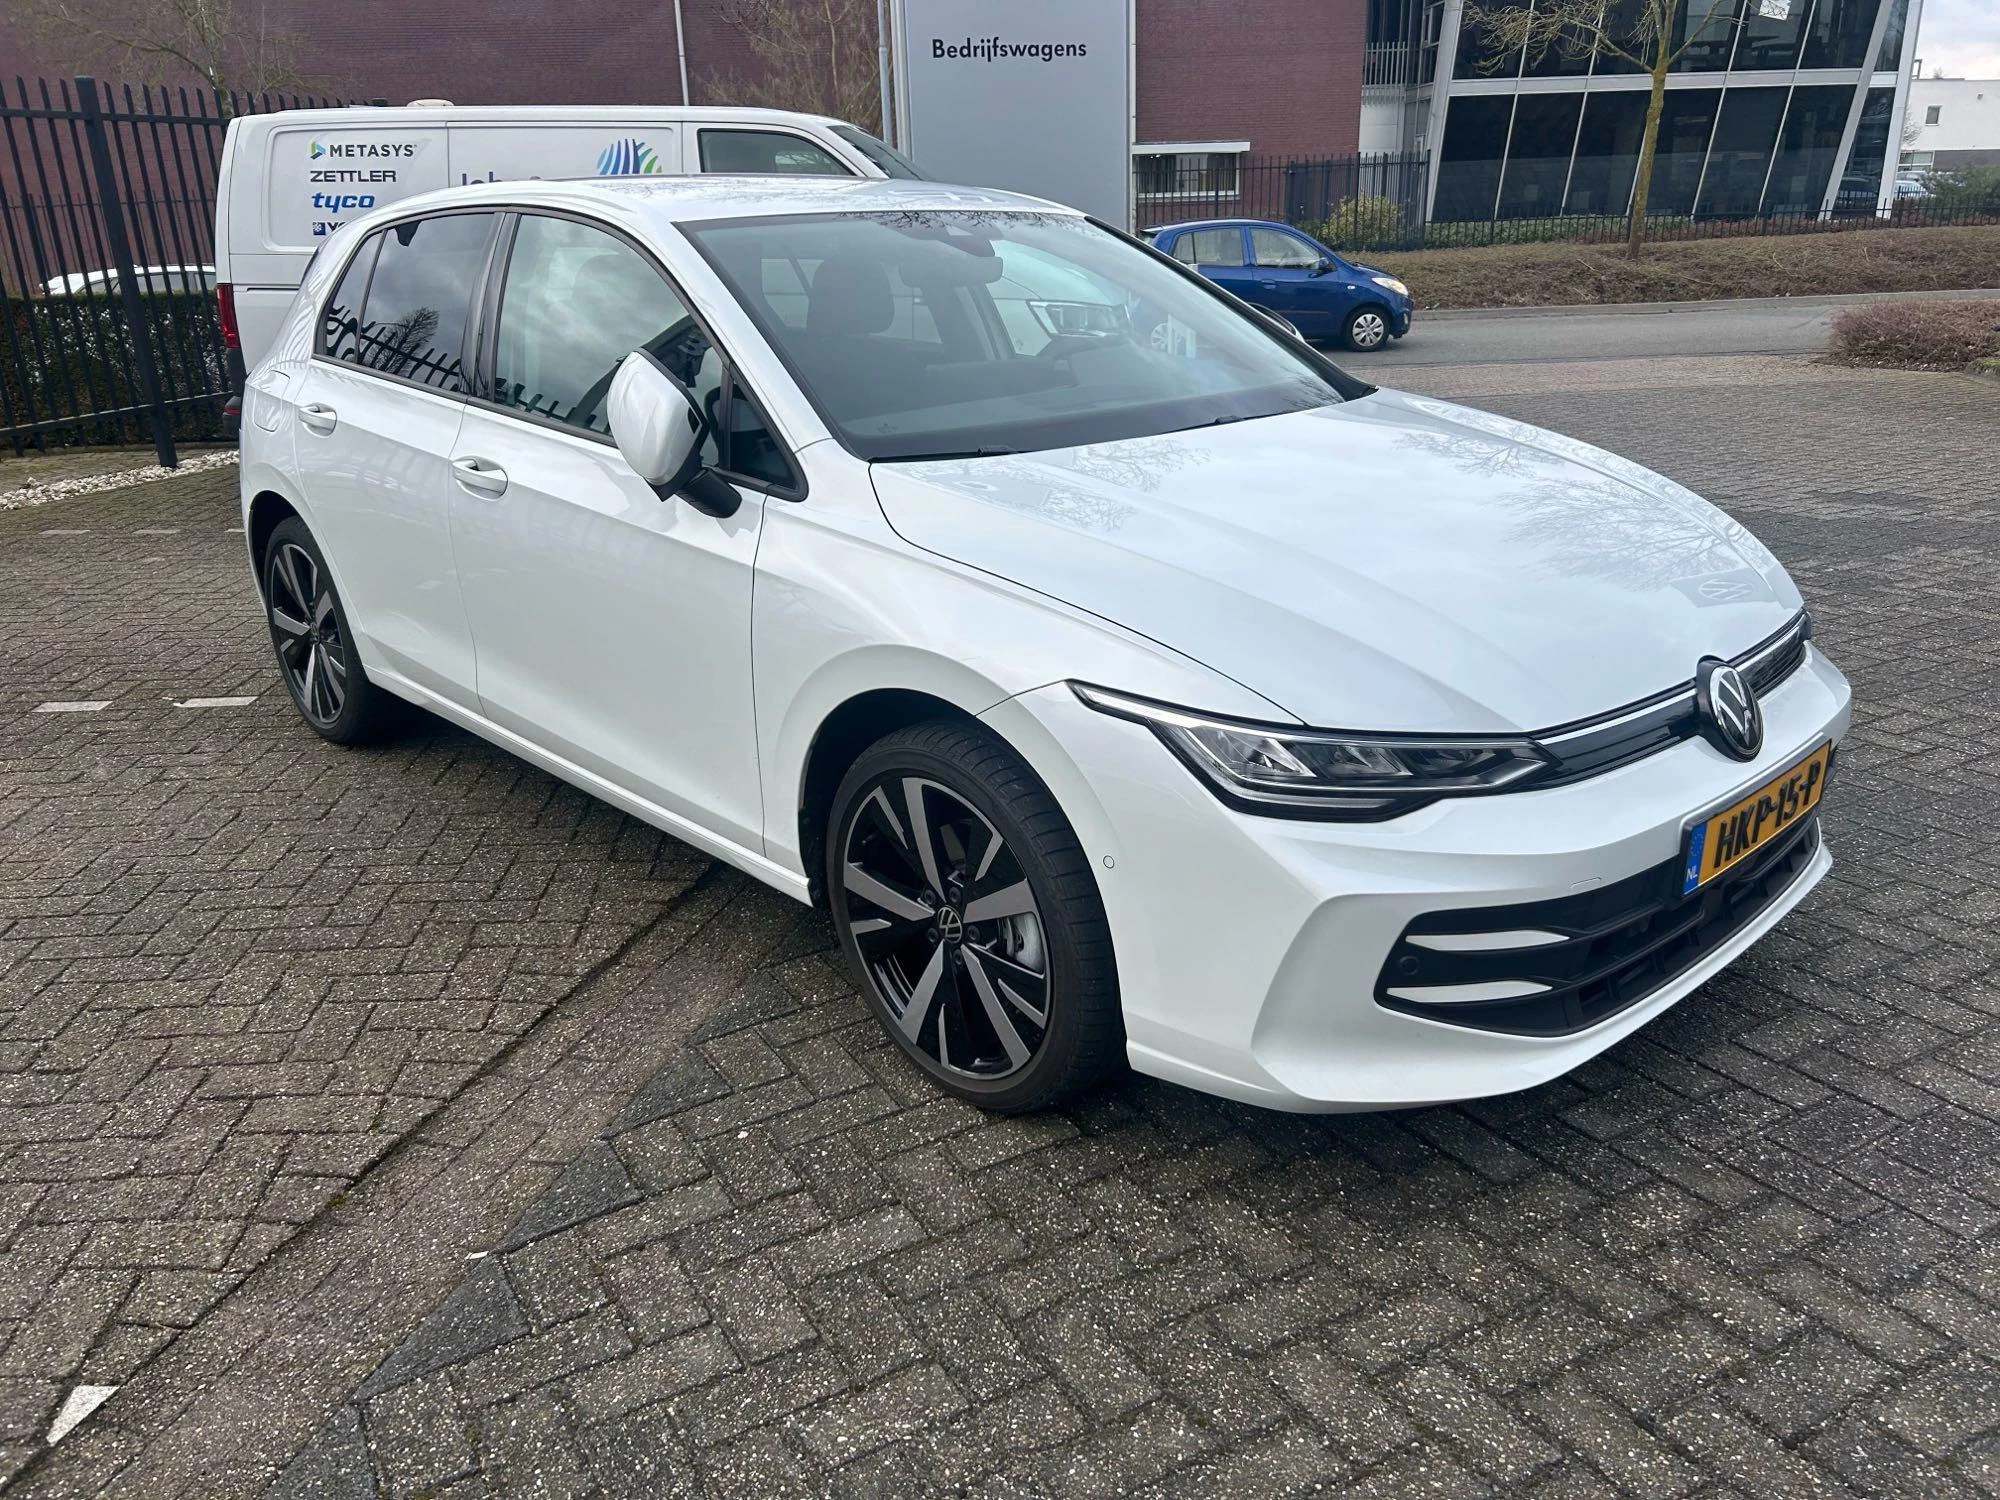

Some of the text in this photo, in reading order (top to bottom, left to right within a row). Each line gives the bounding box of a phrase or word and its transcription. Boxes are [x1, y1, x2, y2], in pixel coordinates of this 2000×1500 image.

[931, 36, 1087, 63] Bedrijfswagens
[329, 144, 414, 158] METASYS
[310, 170, 397, 182] ZETTLER
[311, 192, 375, 213] tyco
[1713, 759, 1821, 868] HKP-15-P
[1685, 865, 1699, 882] NL
